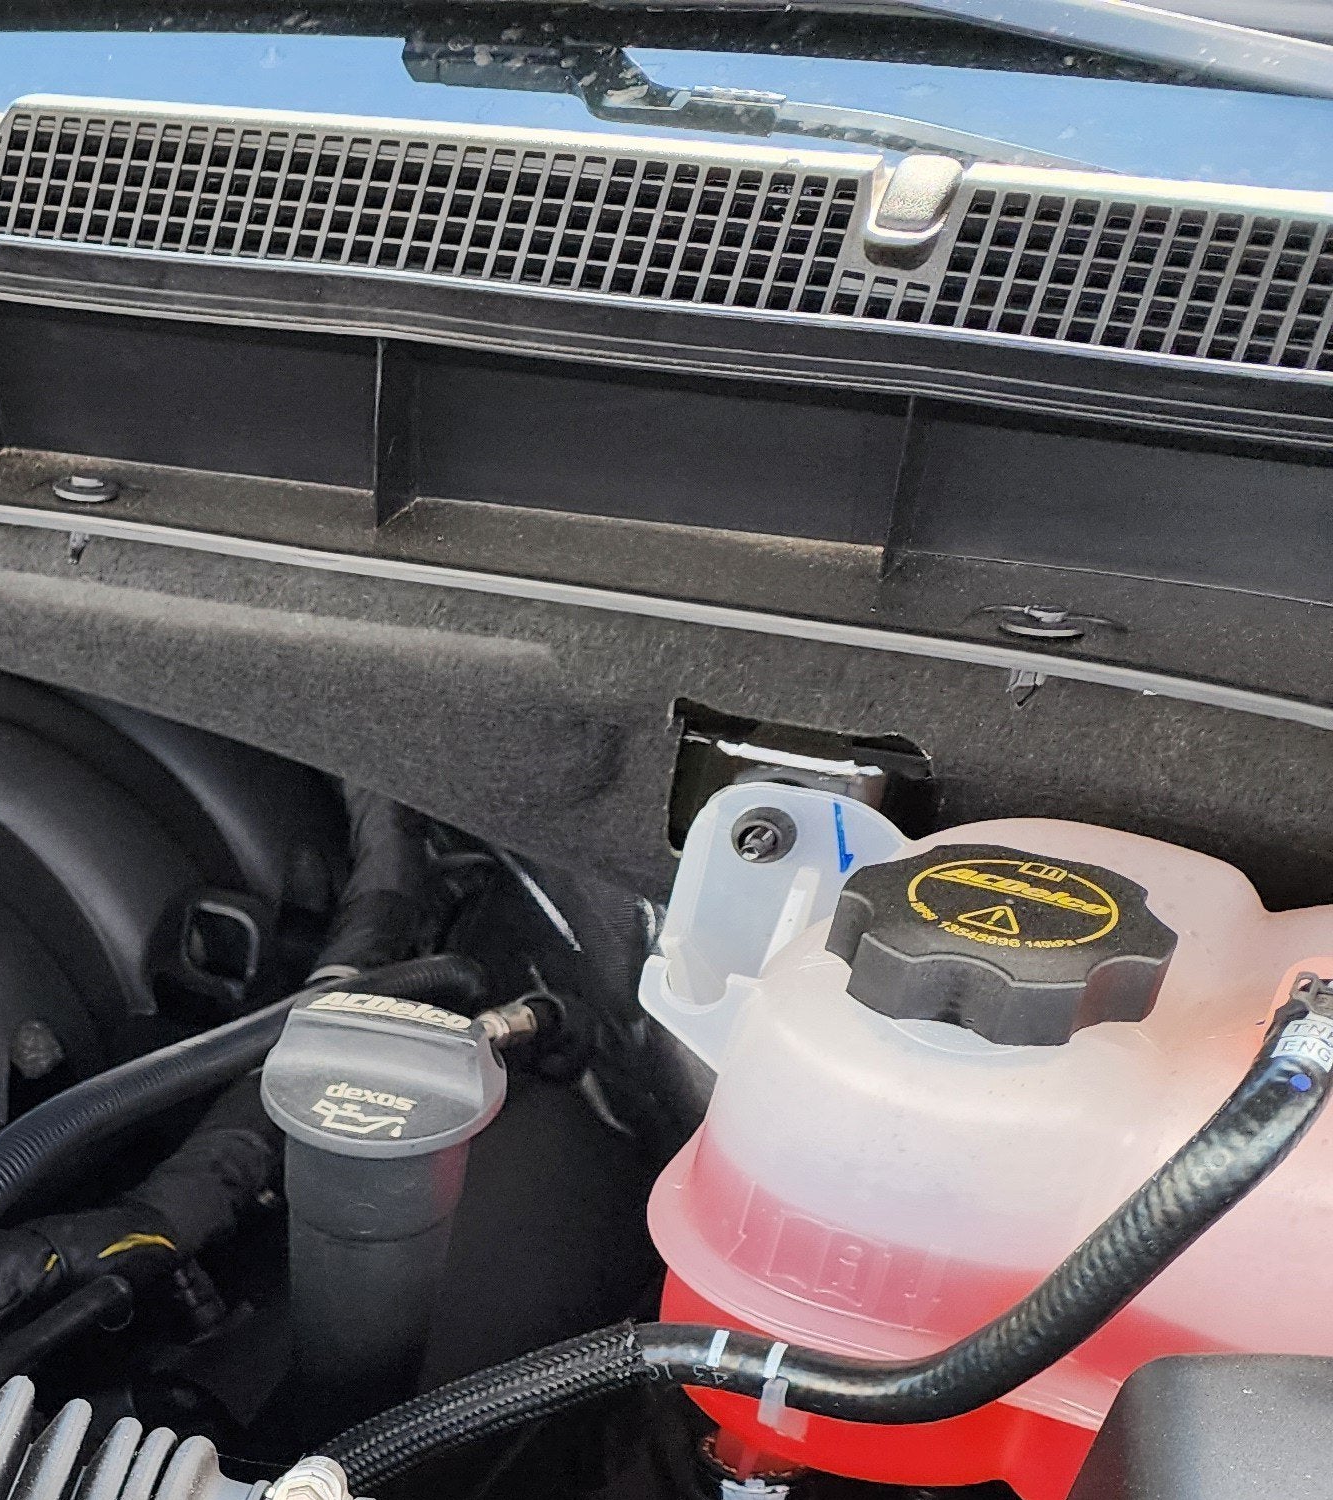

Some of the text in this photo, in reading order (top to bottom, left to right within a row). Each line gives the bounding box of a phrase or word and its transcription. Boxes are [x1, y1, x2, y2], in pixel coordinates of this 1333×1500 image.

[929, 868, 1112, 915] ACDelco
[308, 991, 472, 1032] ACDelco
[1282, 1040, 1331, 1063] ENG
[324, 1081, 418, 1111] dexos
